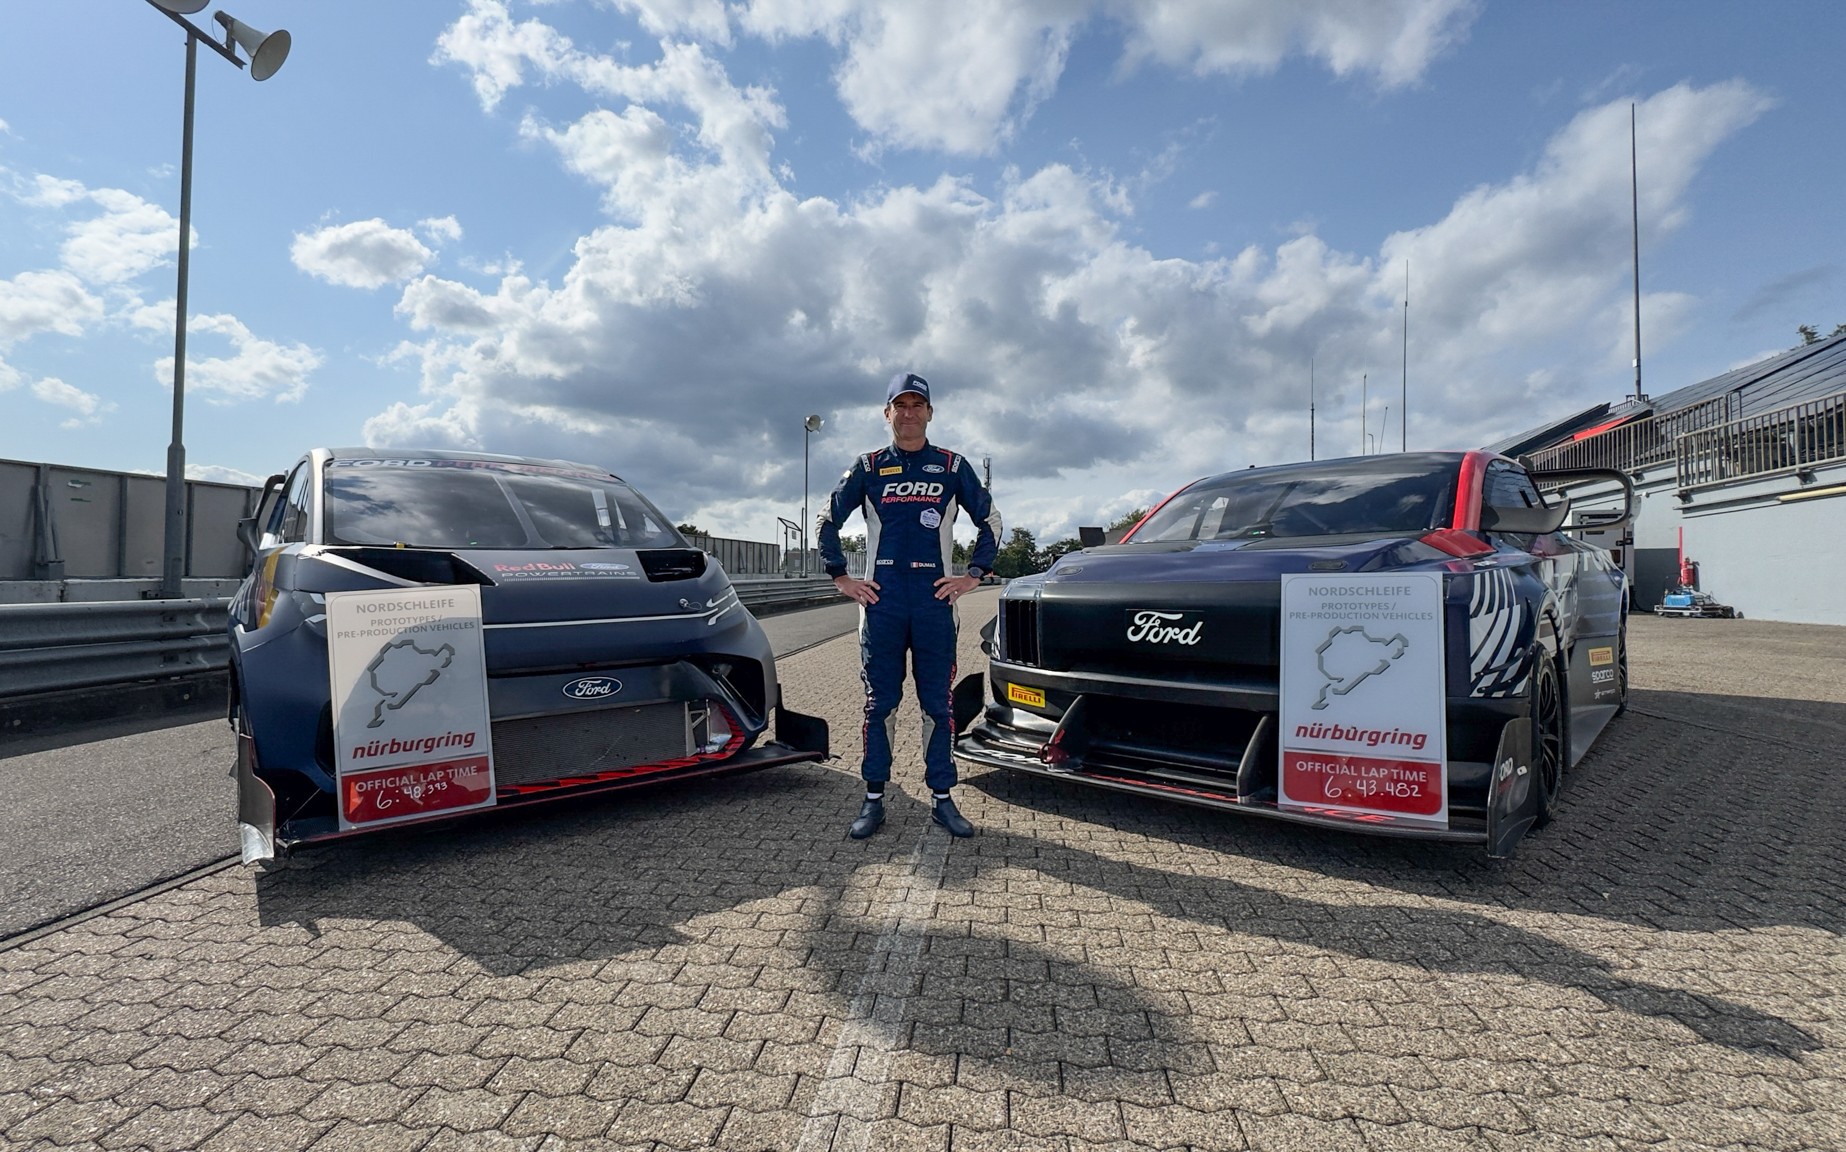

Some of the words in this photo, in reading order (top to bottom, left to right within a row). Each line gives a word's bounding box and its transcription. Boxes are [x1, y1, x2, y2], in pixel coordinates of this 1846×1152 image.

[331, 459, 432, 468] FORD
[882, 481, 944, 497] FORD
[881, 495, 942, 504] PERFORMANCE
[1308, 586, 1411, 597] NORDSCHLEIFE
[356, 598, 455, 614] NORDSCHLEIFE
[1321, 602, 1389, 610] PROTOTYPES
[371, 614, 435, 627] PROTOTYPES
[1289, 612, 1379, 620] PRE-PRODUCTION
[1381, 612, 1433, 621] VEHICLES
[337, 626, 428, 639] PRE-PRODUCTION
[429, 621, 475, 632] VEHICLES
[1126, 611, 1204, 645] Ford
[1592, 669, 1614, 681] sparco
[575, 680, 611, 696] Ford
[1012, 686, 1042, 704] PIRELLI
[1295, 722, 1427, 750] nürburgring
[352, 731, 476, 760] nürburgring
[355, 775, 417, 793] OFFICIAL
[420, 770, 445, 783] LAP
[447, 765, 478, 779] TIME
[1296, 761, 1358, 776] OFFICIAL
[1361, 766, 1388, 778] LAP
[1391, 768, 1427, 782] TIME
